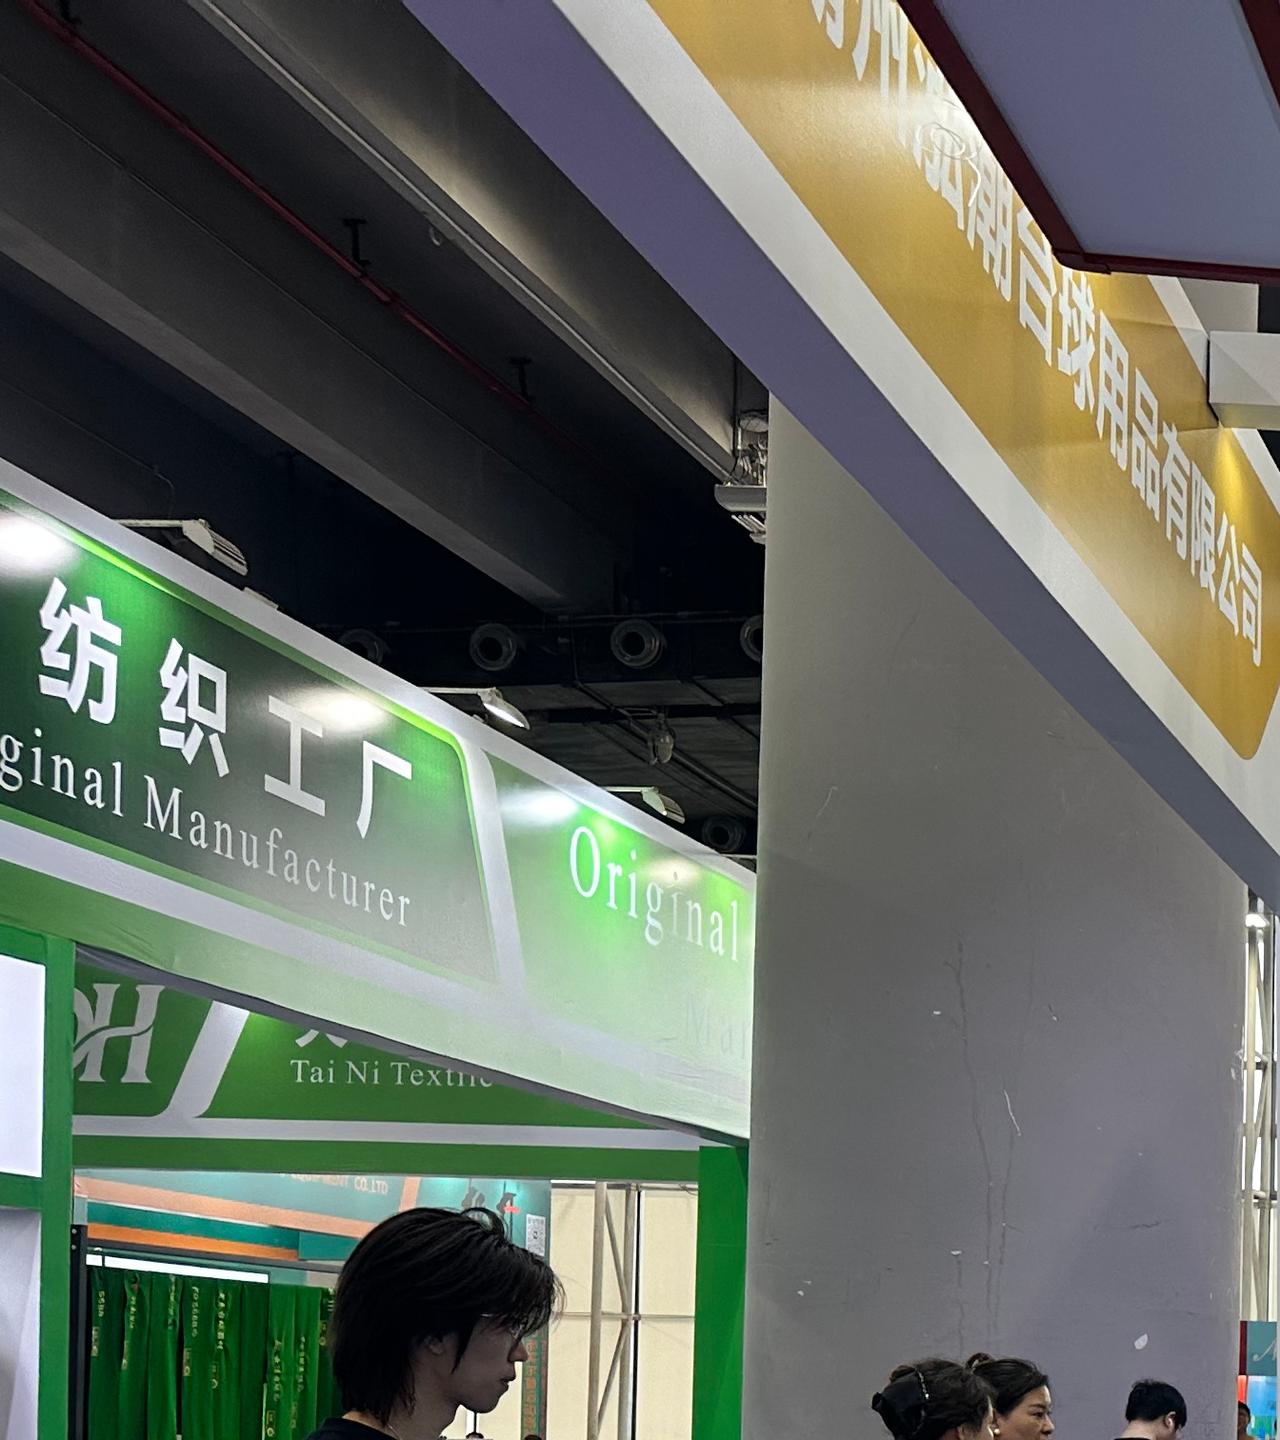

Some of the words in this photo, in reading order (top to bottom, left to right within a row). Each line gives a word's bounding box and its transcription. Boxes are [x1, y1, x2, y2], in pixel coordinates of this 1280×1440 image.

[38, 576, 413, 840] 纺织工厂
[142, 774, 411, 927] Manufacturer
[568, 825, 740, 962] Original
[289, 1059, 335, 1084] Tai
[346, 1060, 380, 1085] Ni
